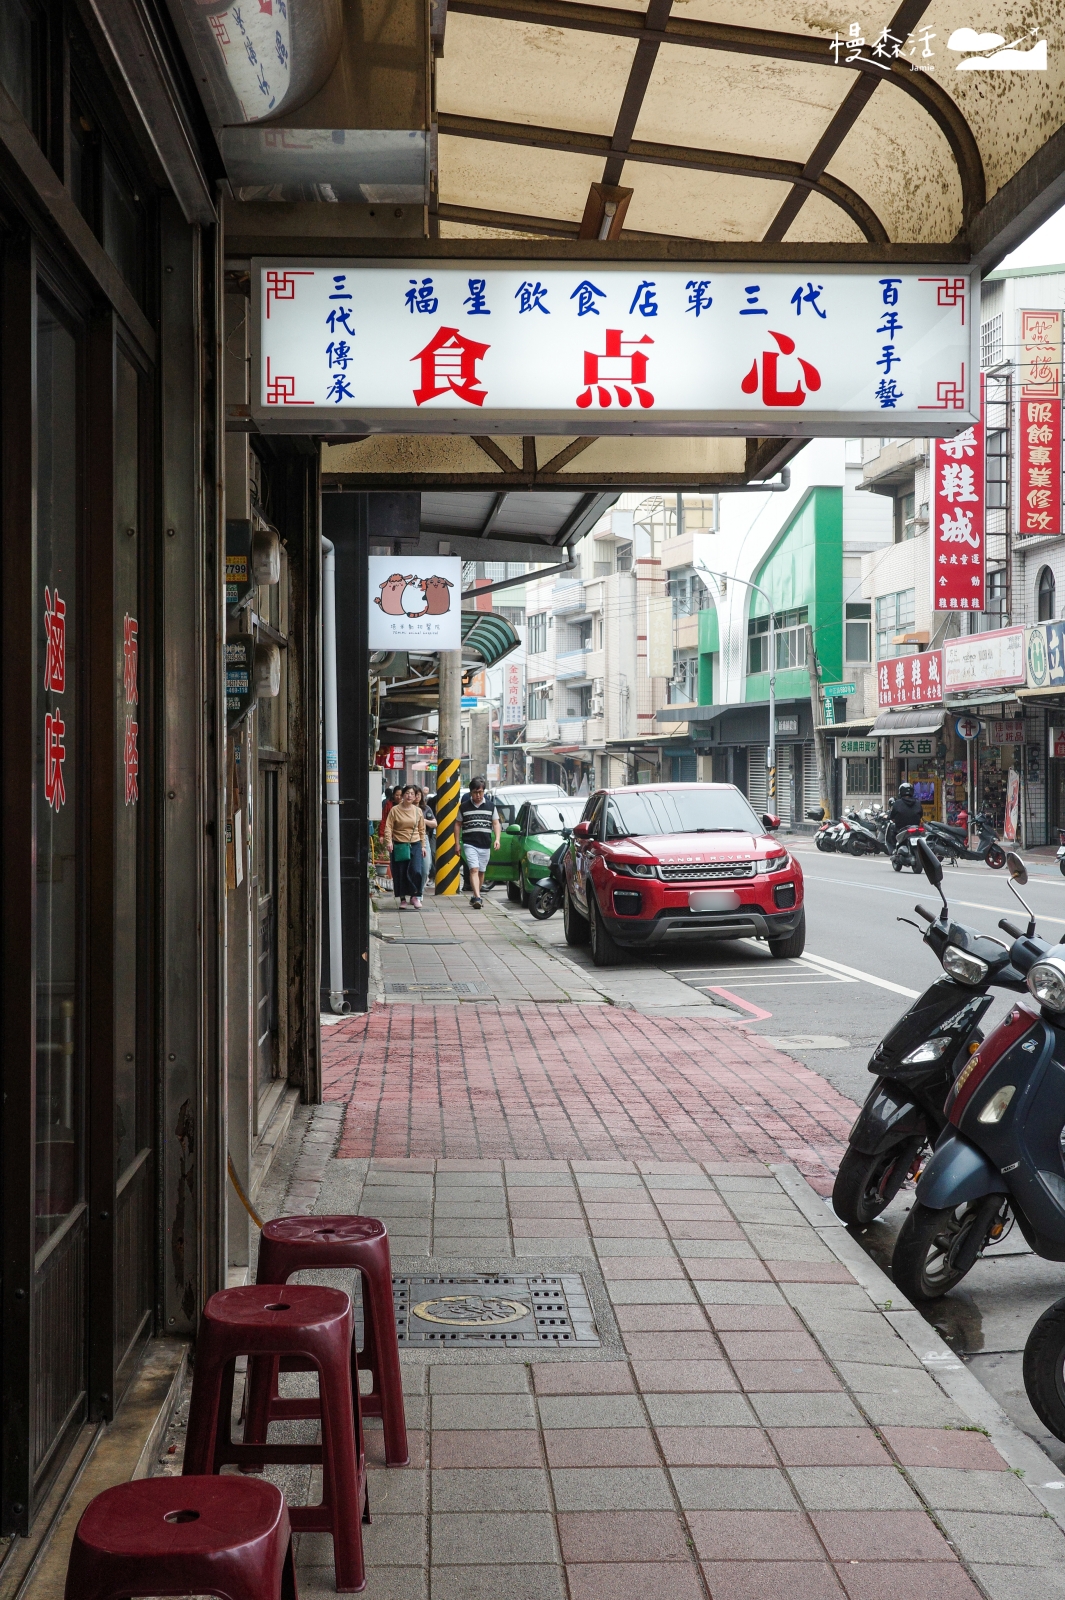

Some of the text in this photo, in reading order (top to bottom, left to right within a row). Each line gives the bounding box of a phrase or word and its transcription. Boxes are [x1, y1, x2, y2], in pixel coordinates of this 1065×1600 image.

[325, 275, 355, 403] 三代傳承
[404, 278, 827, 319] 福星飲食店第三代
[875, 278, 904, 409] 百年手藝
[1026, 402, 1054, 531] 服飾專業修改
[44, 585, 66, 813] 滷味
[880, 655, 940, 690] 佳樂鞋城
[899, 739, 932, 754] 菜苗
